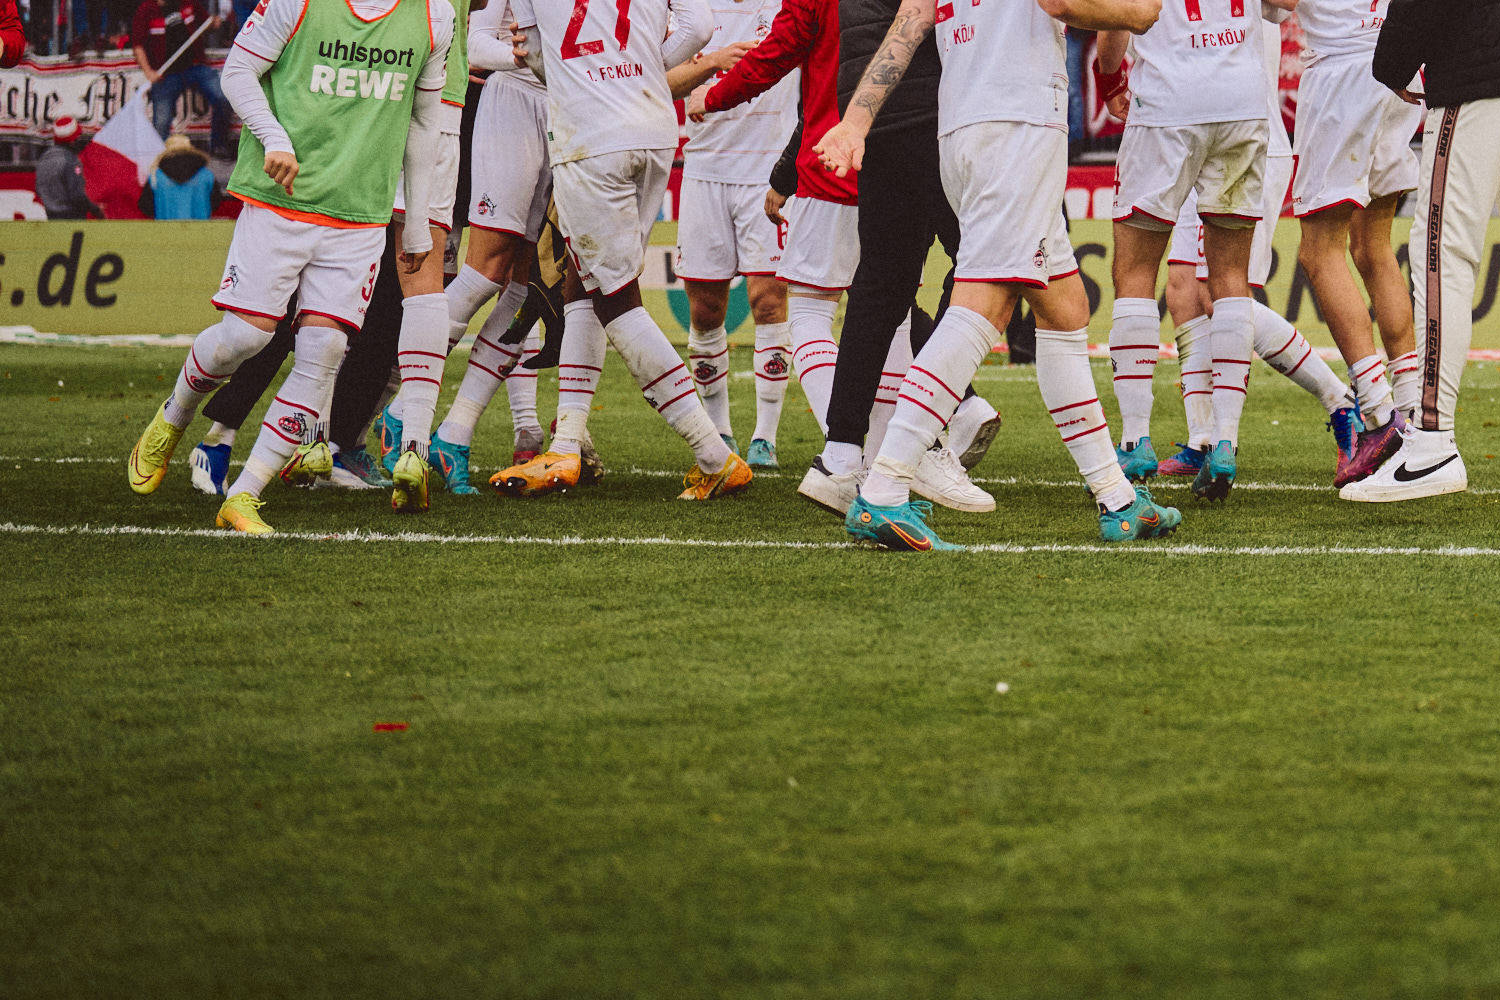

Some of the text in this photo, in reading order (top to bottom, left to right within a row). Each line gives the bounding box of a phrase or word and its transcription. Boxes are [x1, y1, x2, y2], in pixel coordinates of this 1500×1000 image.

[953, 24, 975, 45] KÖLN
[1202, 33, 1217, 47] FC
[1218, 29, 1246, 45] KÖLN
[319, 39, 414, 68] uhlsport
[310, 65, 408, 101] REWE
[1428, 203, 1441, 273] PEGADOR
[0, 230, 125, 308] .de
[1425, 318, 1439, 387] PEGADOR
